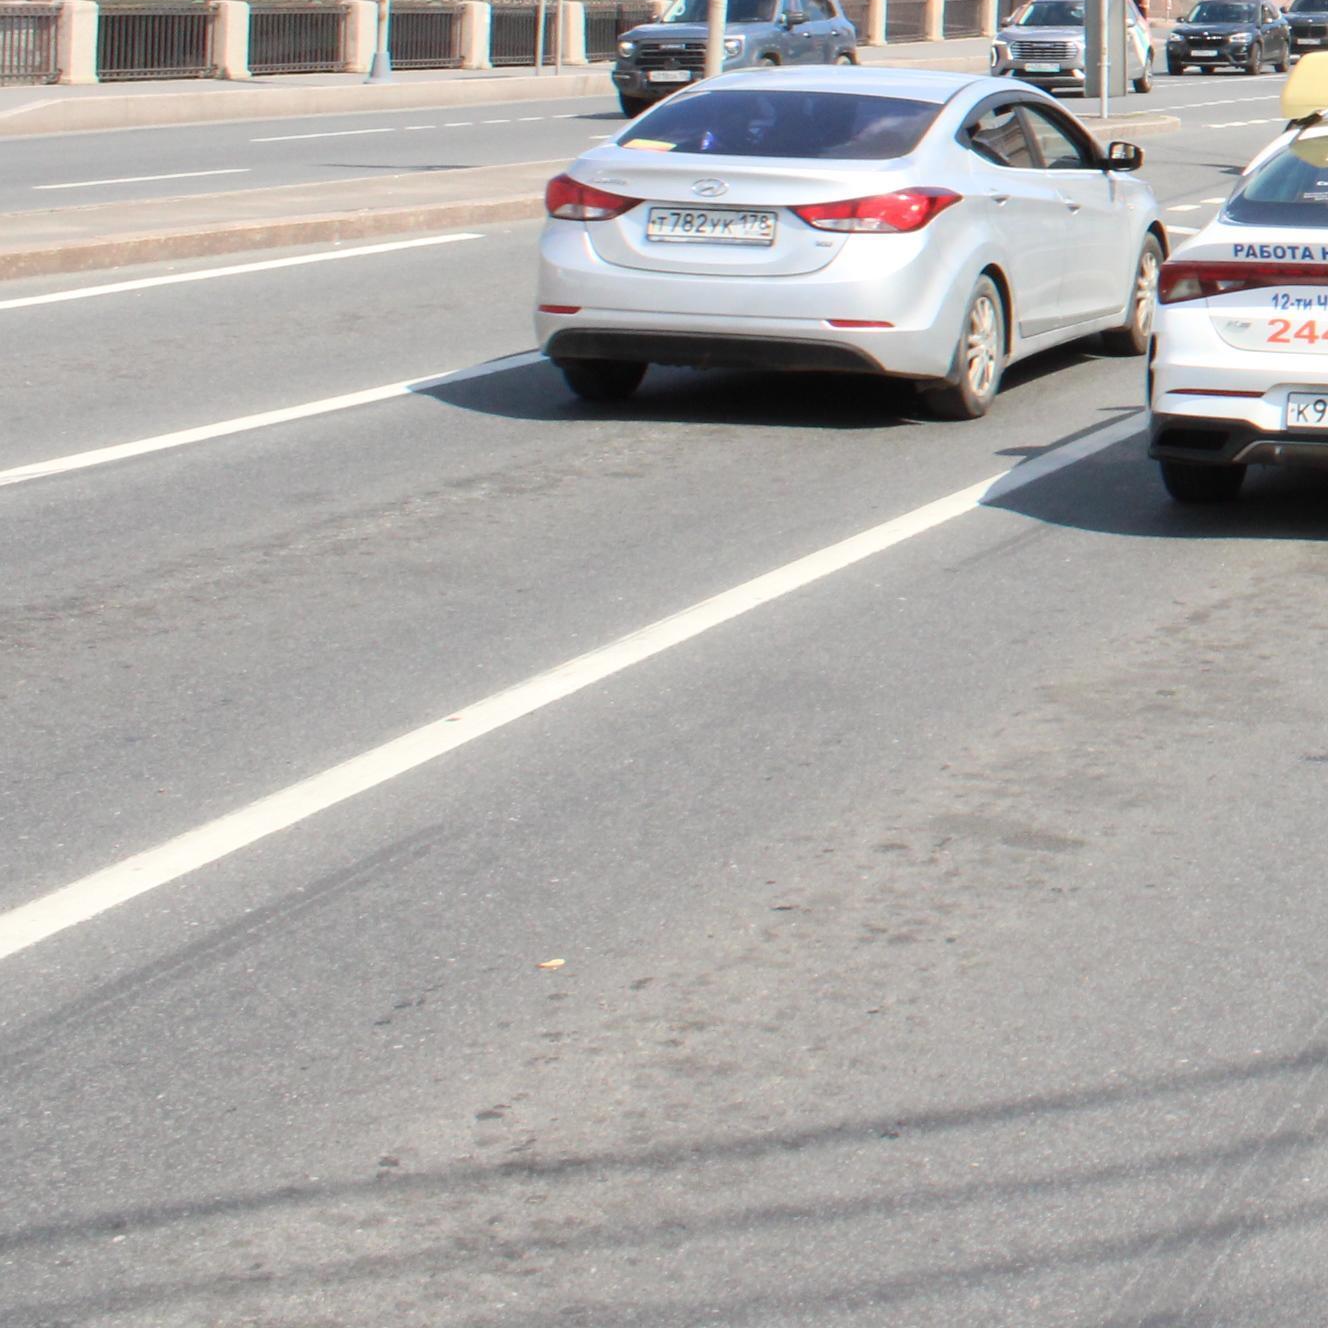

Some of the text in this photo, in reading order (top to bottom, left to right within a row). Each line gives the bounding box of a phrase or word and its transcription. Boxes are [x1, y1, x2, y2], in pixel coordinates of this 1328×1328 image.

[656, 213, 769, 234] Т782УК 178
[1233, 243, 1314, 260] РАБОТА
[1271, 293, 1313, 310] 12-ти
